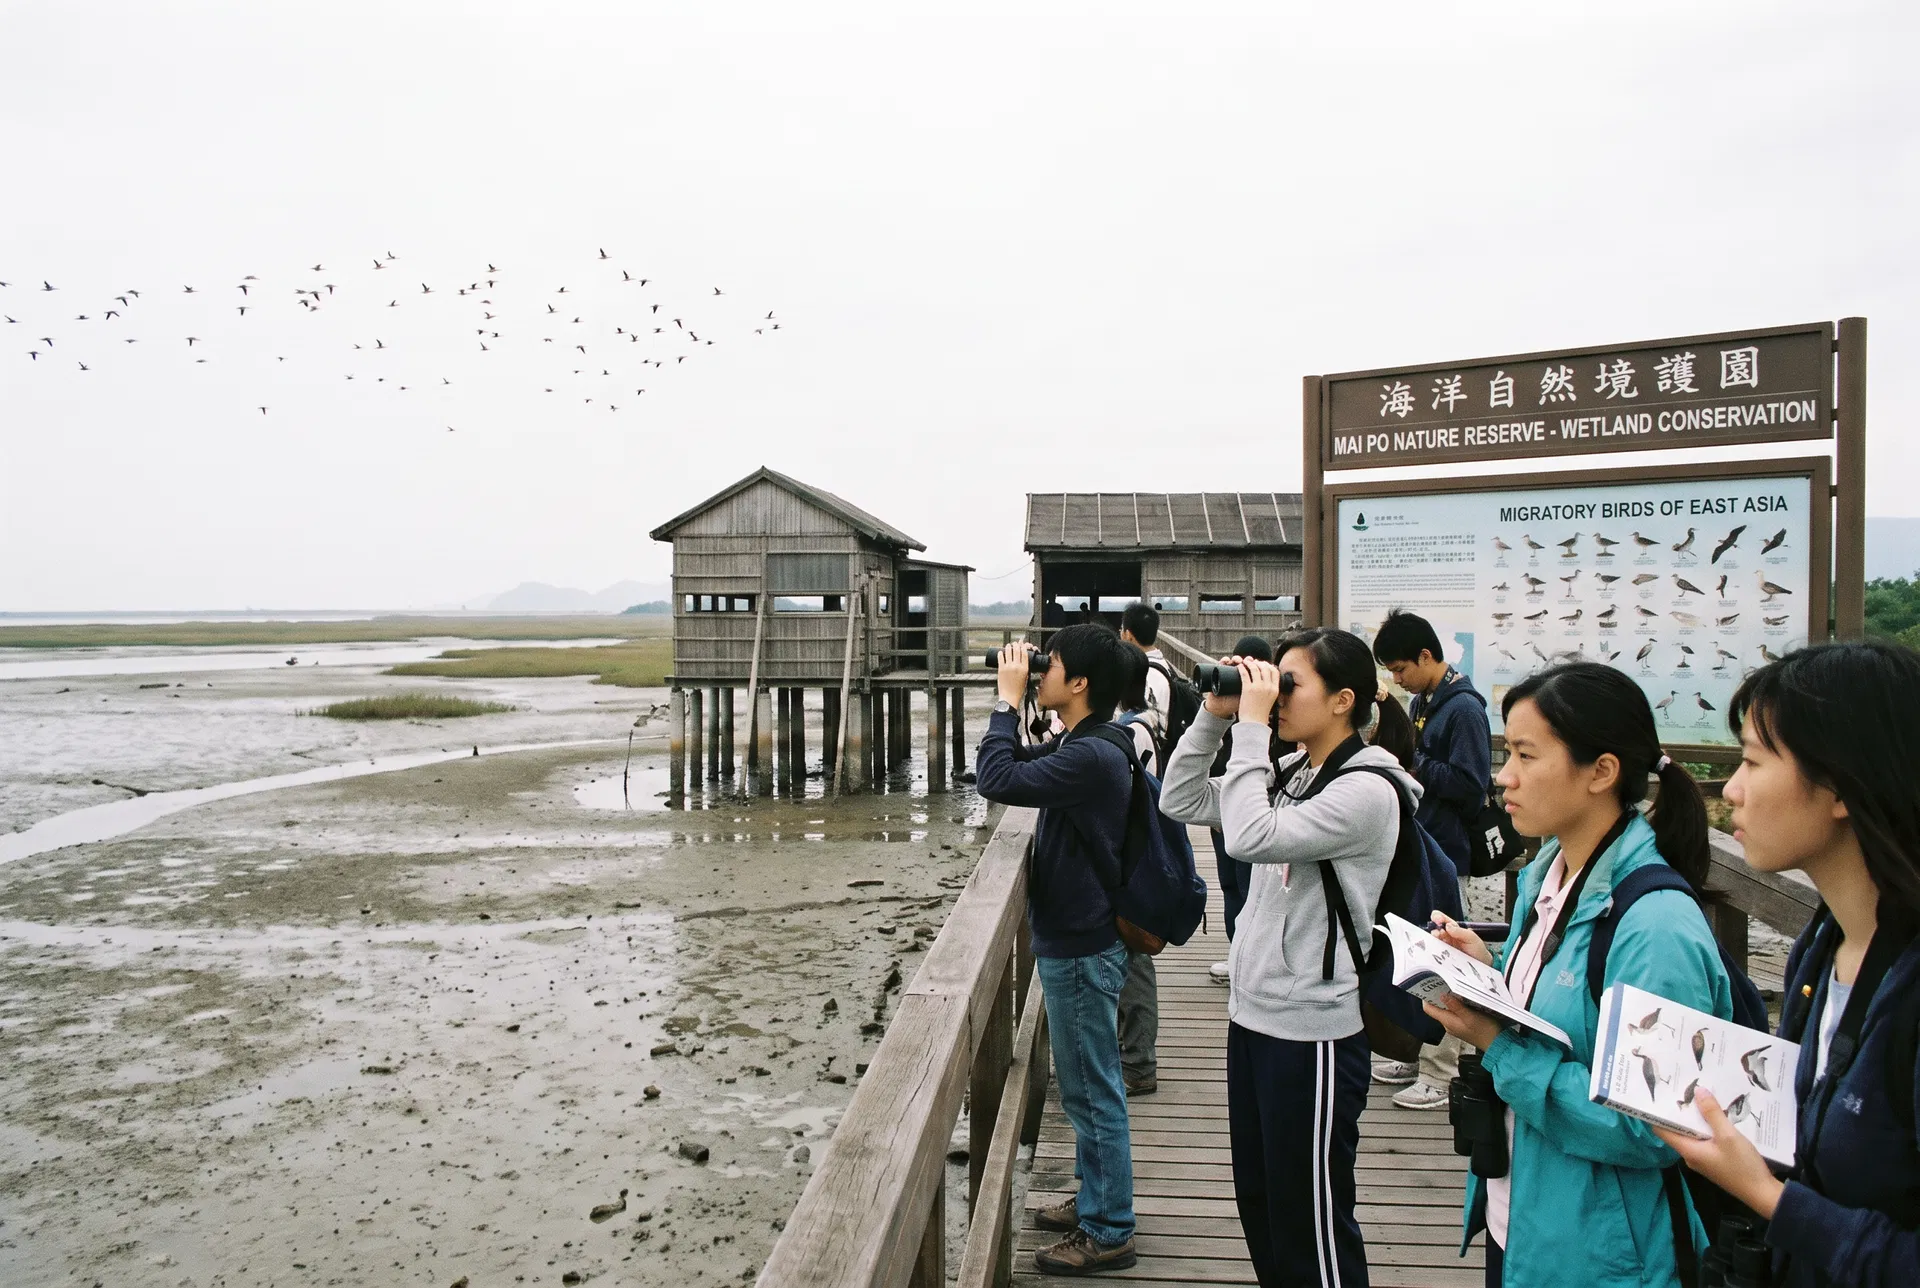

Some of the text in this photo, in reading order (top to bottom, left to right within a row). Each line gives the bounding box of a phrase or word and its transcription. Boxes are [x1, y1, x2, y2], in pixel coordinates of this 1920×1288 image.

[1379, 346, 1759, 419] 海洋自然境護園
[1334, 434, 1363, 456] MAI
[1366, 432, 1390, 454] PO
[1393, 427, 1460, 452] NATURE
[1464, 420, 1546, 446] RESERVE
[1560, 411, 1653, 440] WETLAND
[1657, 399, 1817, 433] CONSERVATION
[1500, 495, 1789, 522] MIGRATORY BIRDS OF EAST ASIA
